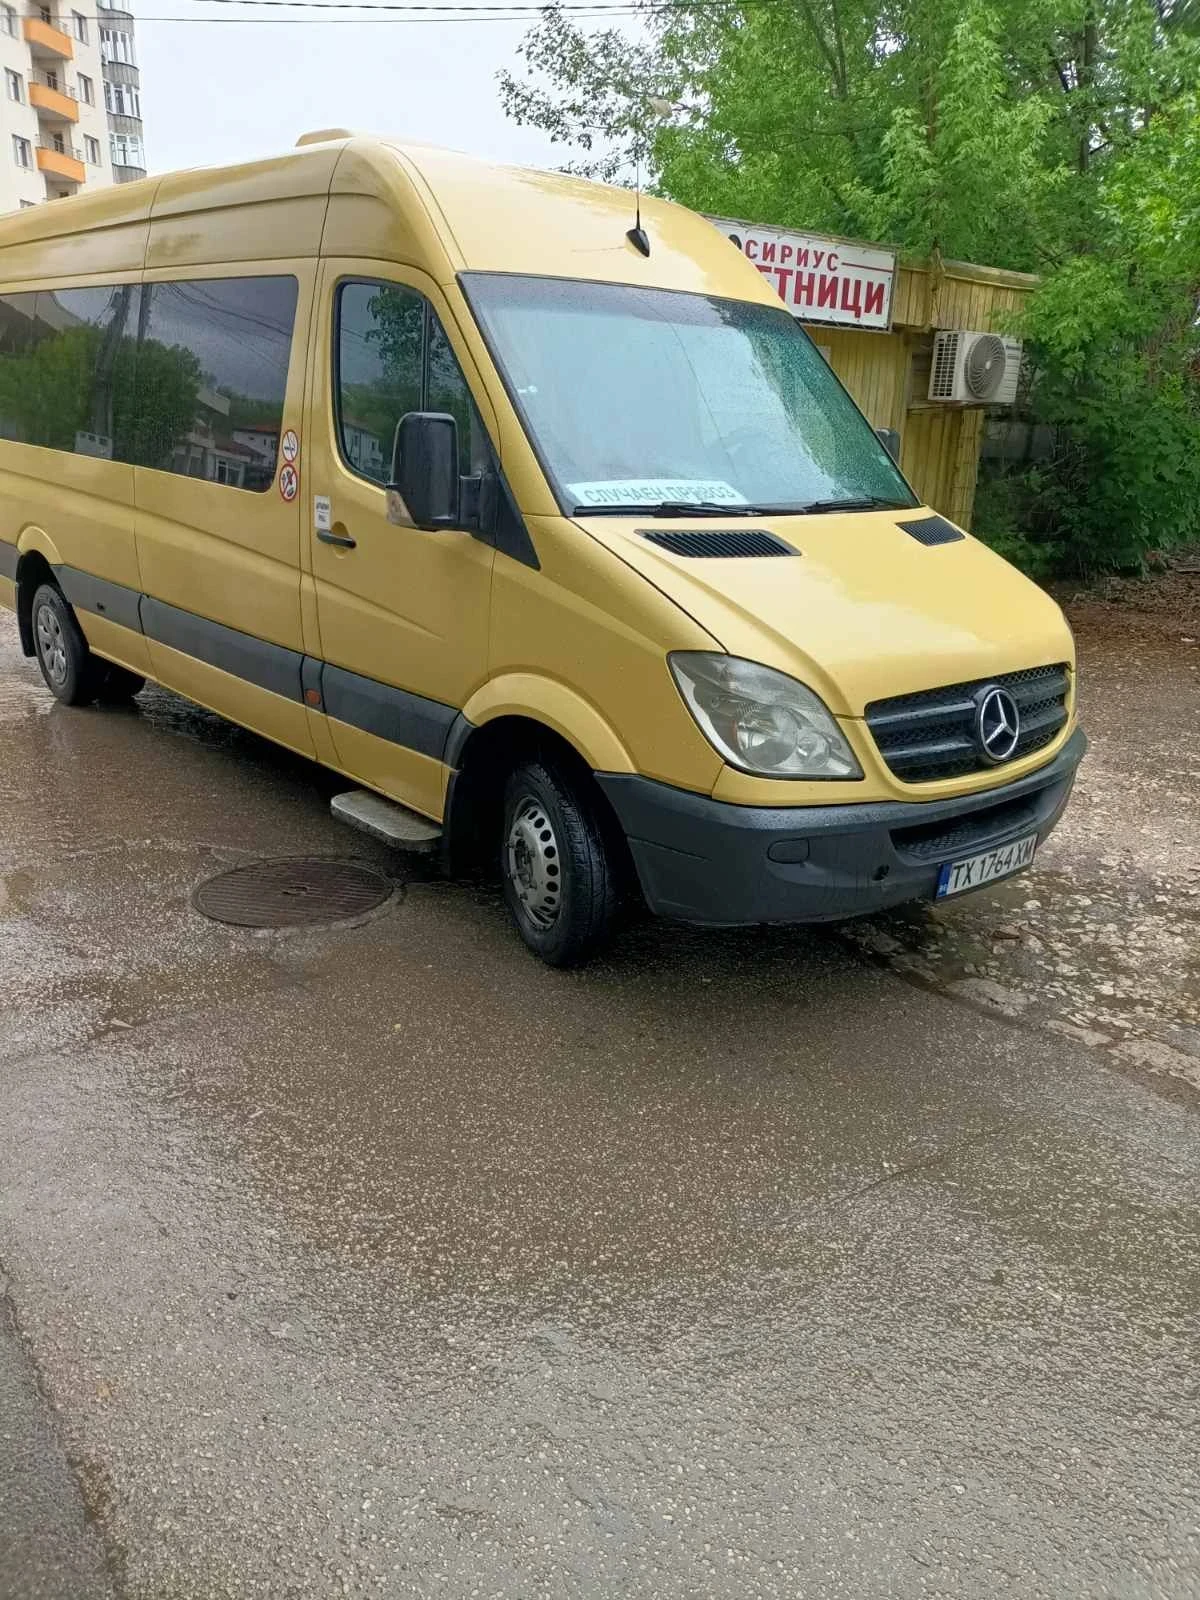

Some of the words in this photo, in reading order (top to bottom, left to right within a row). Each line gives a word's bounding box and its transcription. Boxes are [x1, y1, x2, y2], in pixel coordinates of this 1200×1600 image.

[745, 239, 839, 272] СИРИУС
[756, 264, 885, 318] ТНИЦИ
[584, 486, 668, 503] СЛУЧАЕН
[980, 847, 1014, 881] 1764
